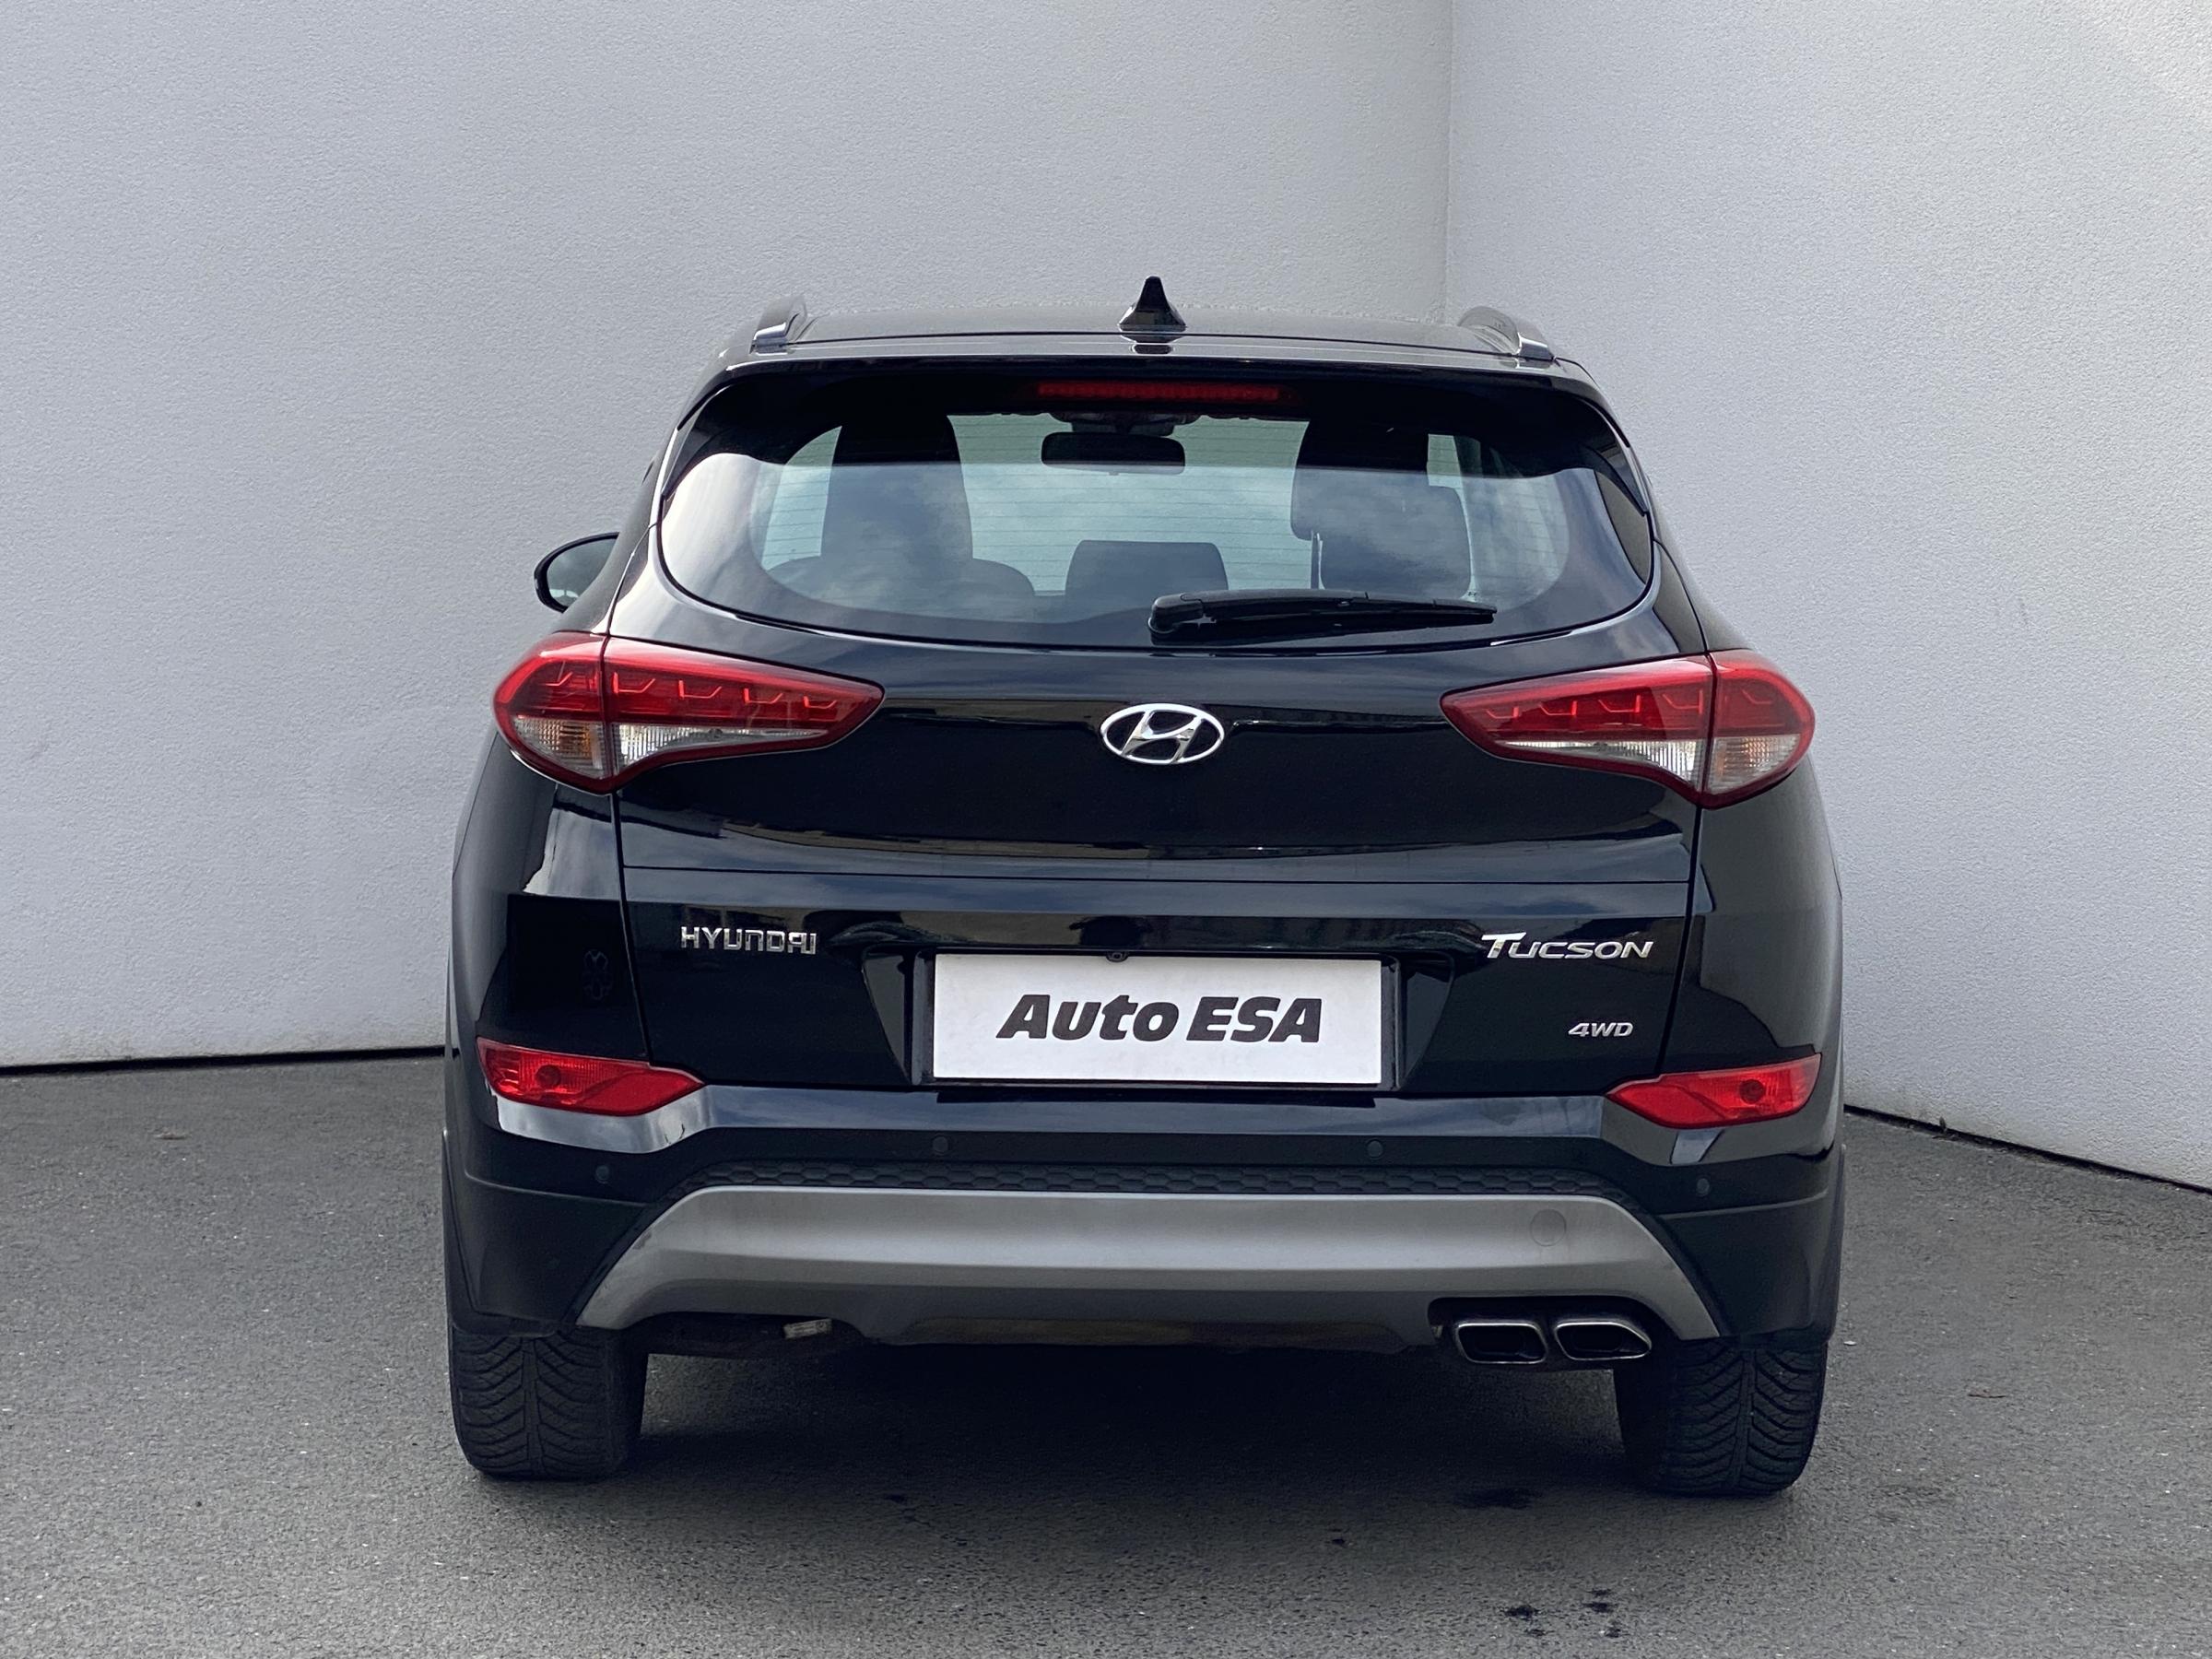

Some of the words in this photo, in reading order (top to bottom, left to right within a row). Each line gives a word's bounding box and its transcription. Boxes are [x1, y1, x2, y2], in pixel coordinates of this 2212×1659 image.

[680, 925, 818, 955] HYUNDAI
[1481, 931, 1654, 959] TUCSON
[995, 994, 1180, 1042] Auto
[1185, 994, 1323, 1043] ESA
[1568, 1021, 1634, 1038] 4WD
